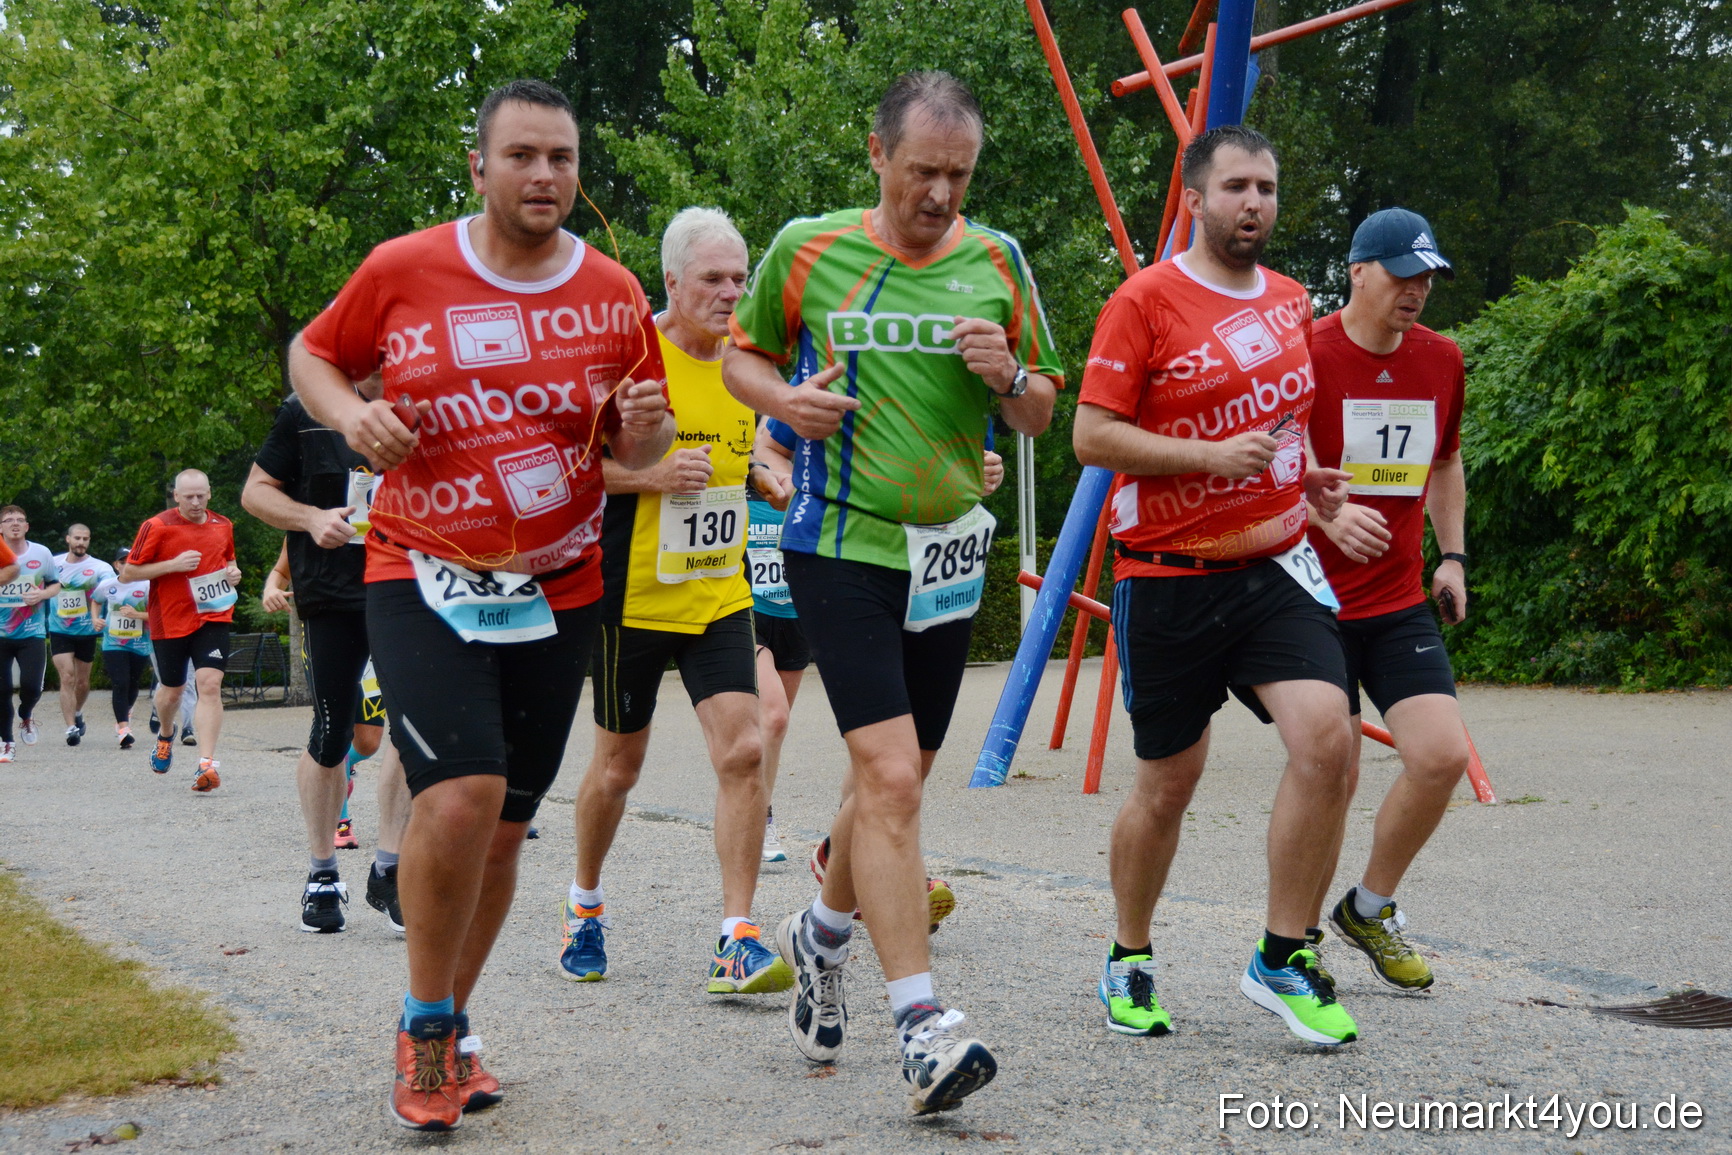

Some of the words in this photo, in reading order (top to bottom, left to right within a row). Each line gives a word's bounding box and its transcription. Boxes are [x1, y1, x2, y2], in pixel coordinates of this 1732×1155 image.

[453, 308, 516, 324] raumbox
[1219, 313, 1257, 338] raumbox
[540, 342, 606, 361] schenken
[1176, 371, 1229, 399] outdoor
[1388, 404, 1428, 416] BOCK
[455, 431, 516, 451] wohnen
[526, 418, 580, 438] outdoor
[676, 431, 721, 442] Norbert
[1376, 424, 1412, 459] 17
[501, 451, 557, 475] raumbox
[1372, 468, 1409, 483] Oliver
[707, 490, 745, 503] BOCK
[437, 515, 498, 535] outdoor
[684, 509, 736, 547] 130
[529, 525, 590, 570] raumbox
[922, 527, 990, 587] 2894
[686, 554, 726, 570] Norbert
[754, 562, 786, 585] 20
[197, 579, 231, 601] 3010
[935, 585, 976, 612] Helmut
[62, 598, 81, 608] 332
[117, 619, 136, 629] 104
[478, 608, 511, 628] Andi
